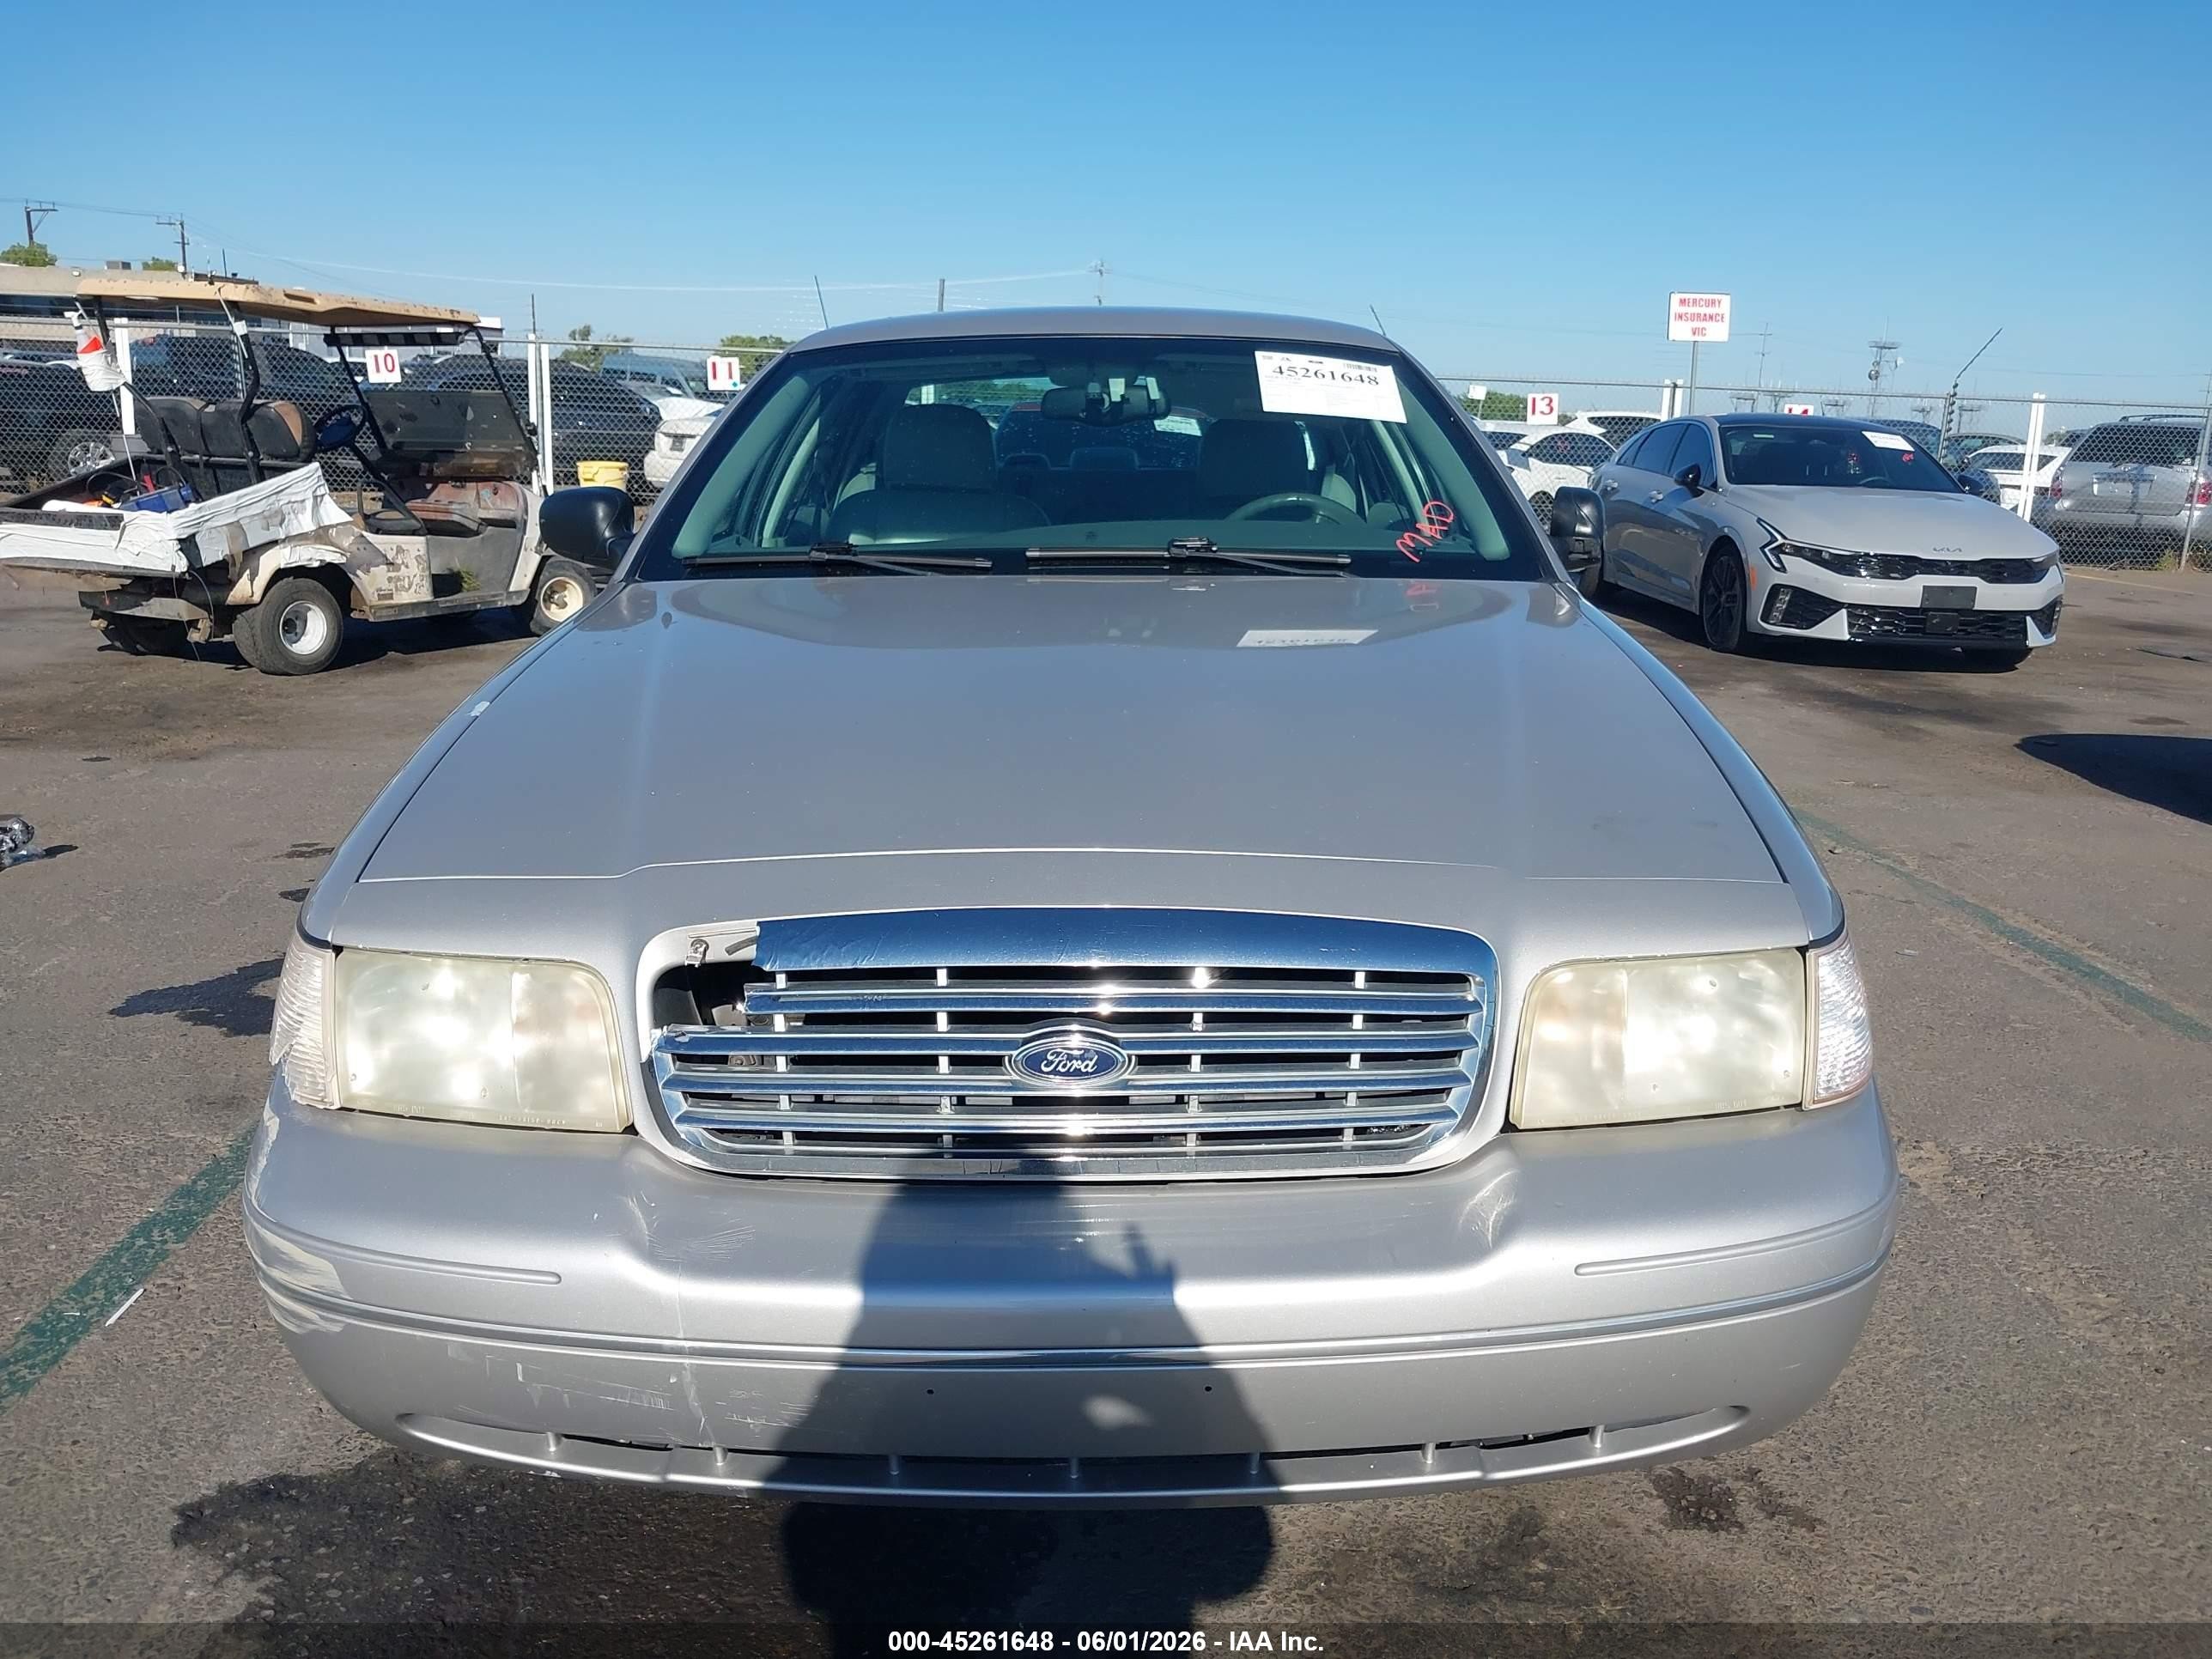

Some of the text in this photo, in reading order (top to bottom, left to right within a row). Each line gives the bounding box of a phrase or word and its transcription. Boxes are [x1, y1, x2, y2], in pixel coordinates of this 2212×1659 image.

[1678, 297, 1723, 308] MERCURY
[1674, 312, 1726, 323] INSURANCE
[1691, 326, 1707, 337] VIC
[374, 353, 396, 374] 10
[712, 362, 733, 380] 11
[1272, 365, 1380, 386] 45261648
[1531, 396, 1554, 416] 13
[1395, 501, 1454, 563] MAD
[1040, 1048, 1098, 1073] Ford
